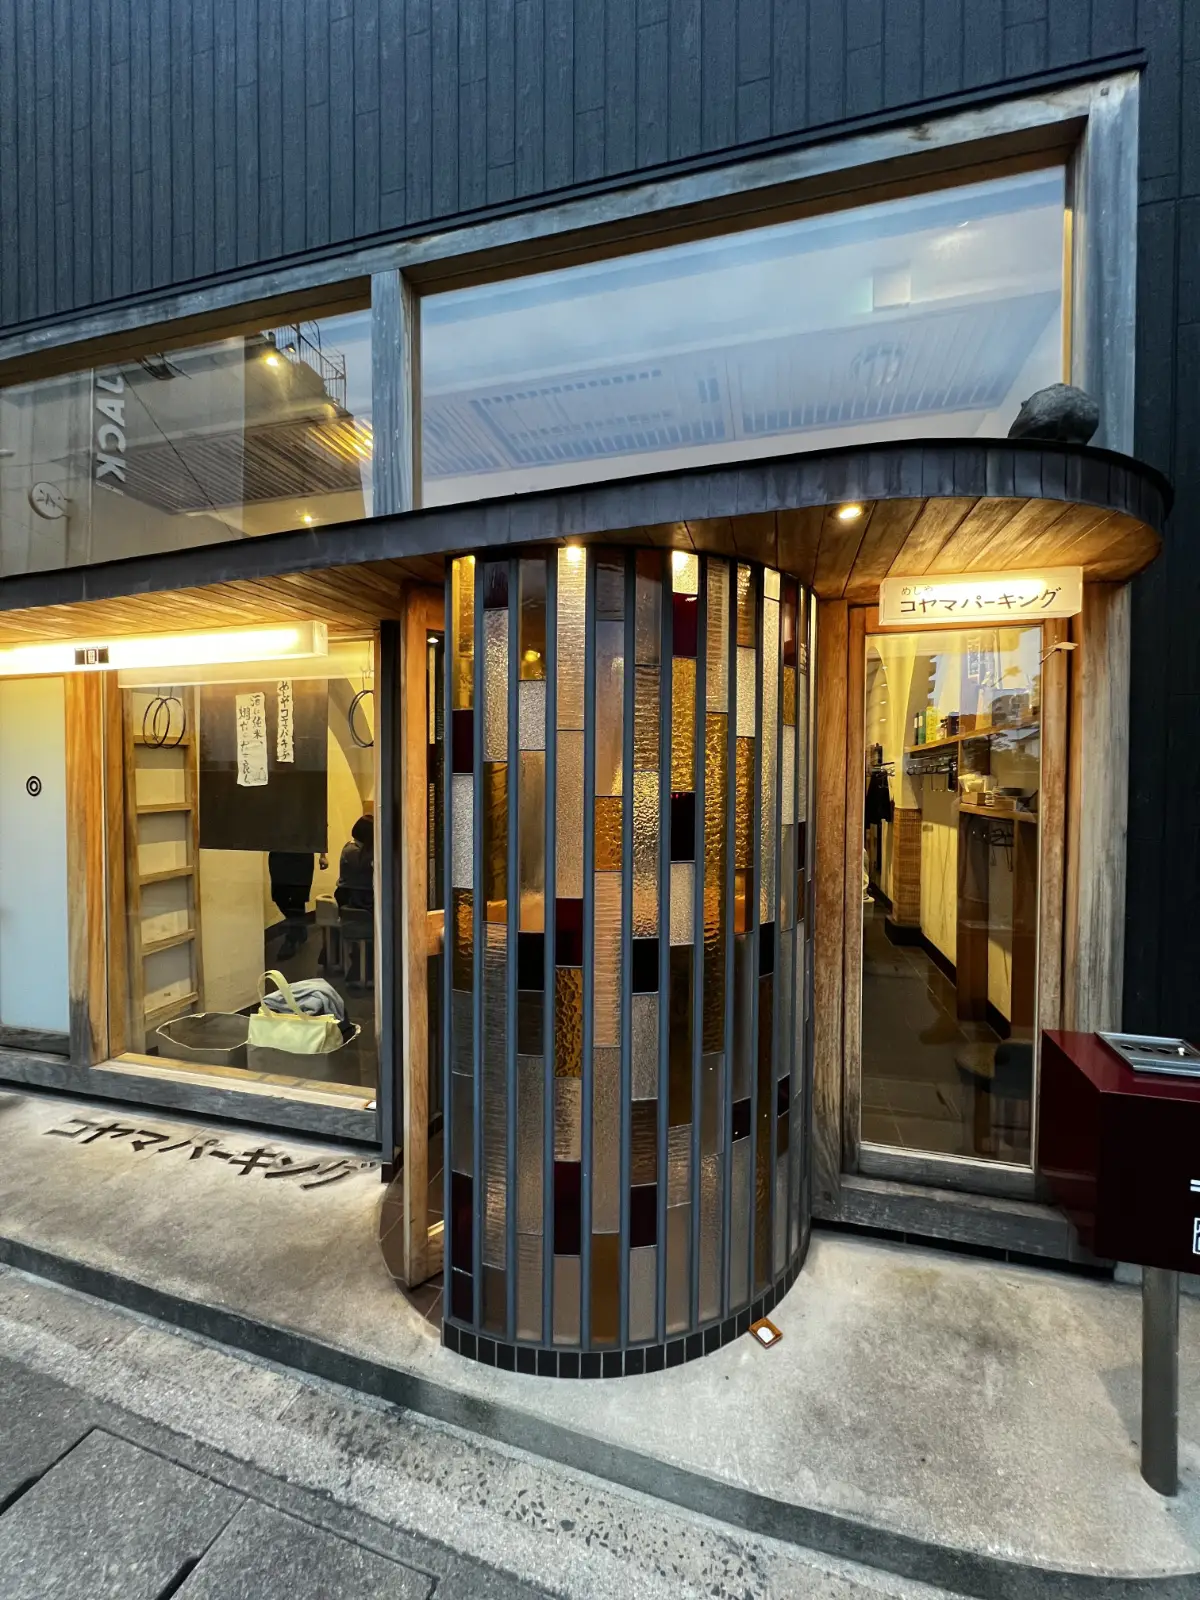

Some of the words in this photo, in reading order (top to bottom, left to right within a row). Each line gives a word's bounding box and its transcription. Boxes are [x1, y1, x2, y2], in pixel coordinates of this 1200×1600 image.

[900, 586, 1061, 612] コヤマパーキング
[42, 1118, 378, 1190] コヤマパーキング
